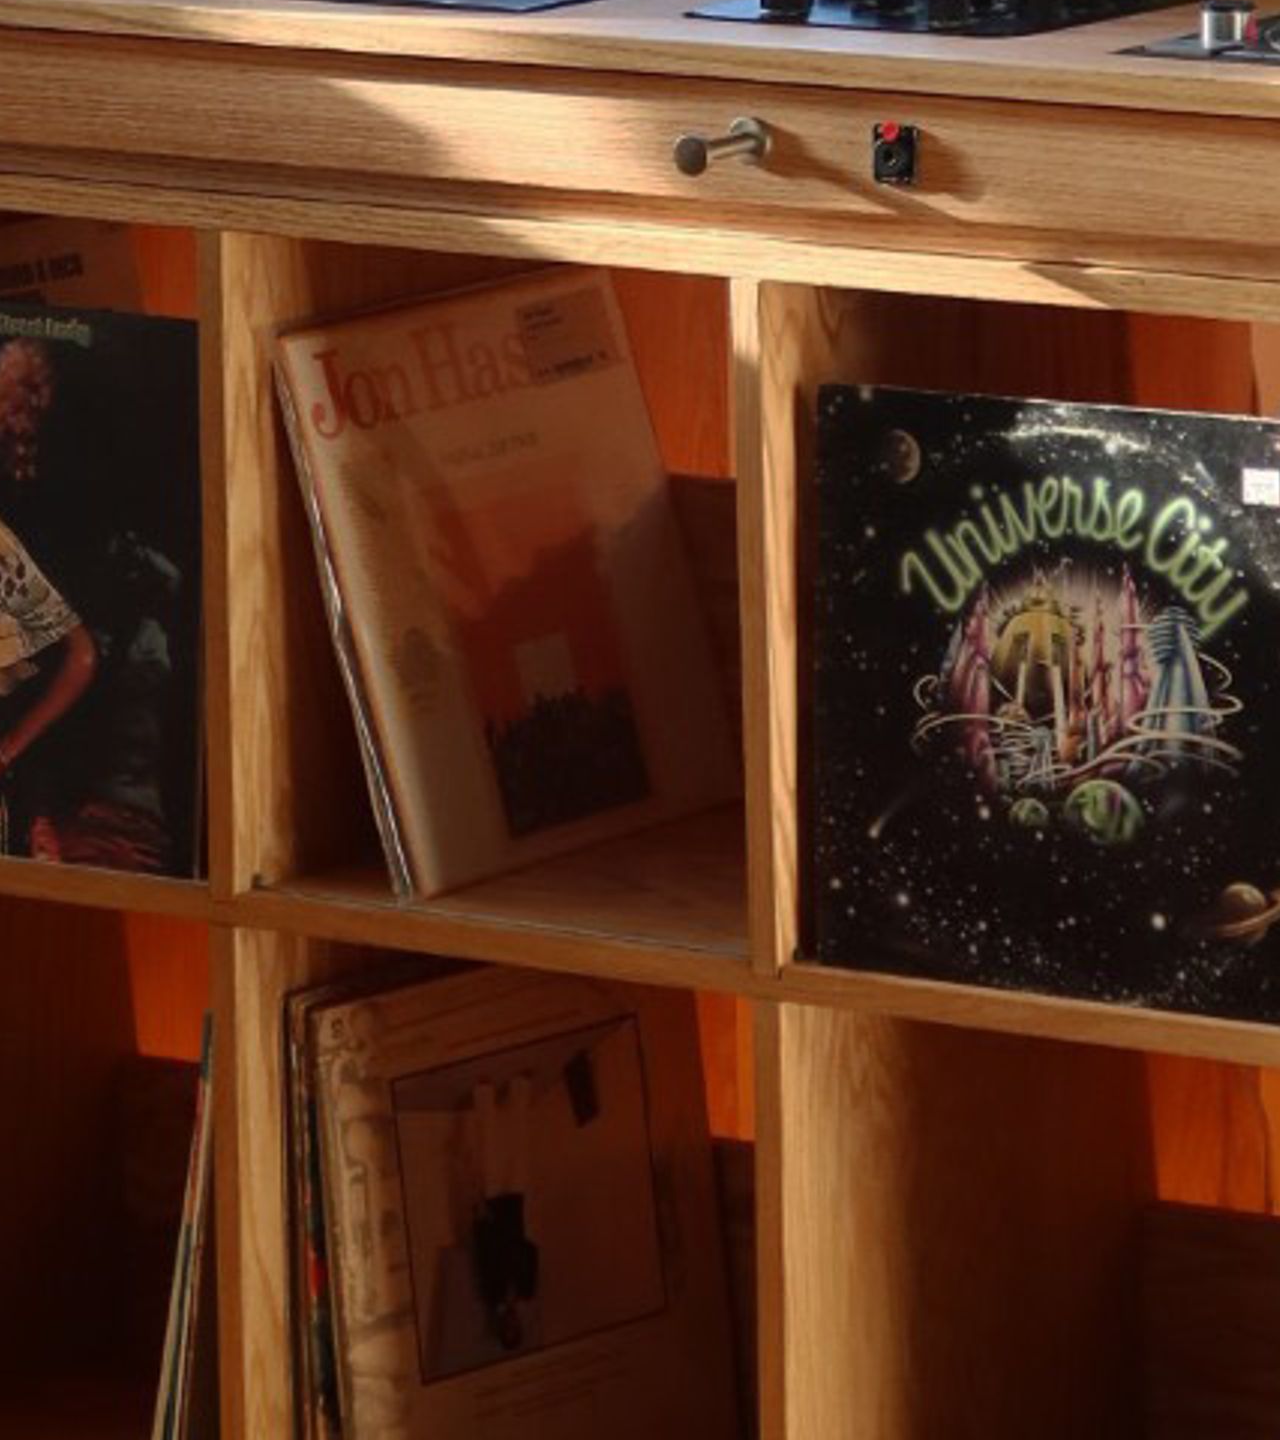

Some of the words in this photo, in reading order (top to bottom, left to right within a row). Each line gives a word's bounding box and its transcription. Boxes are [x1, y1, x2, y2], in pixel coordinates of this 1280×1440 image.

[311, 348, 422, 441] Jon
[407, 320, 532, 412] Has
[899, 475, 1145, 614] Universe
[1145, 495, 1250, 642] City
